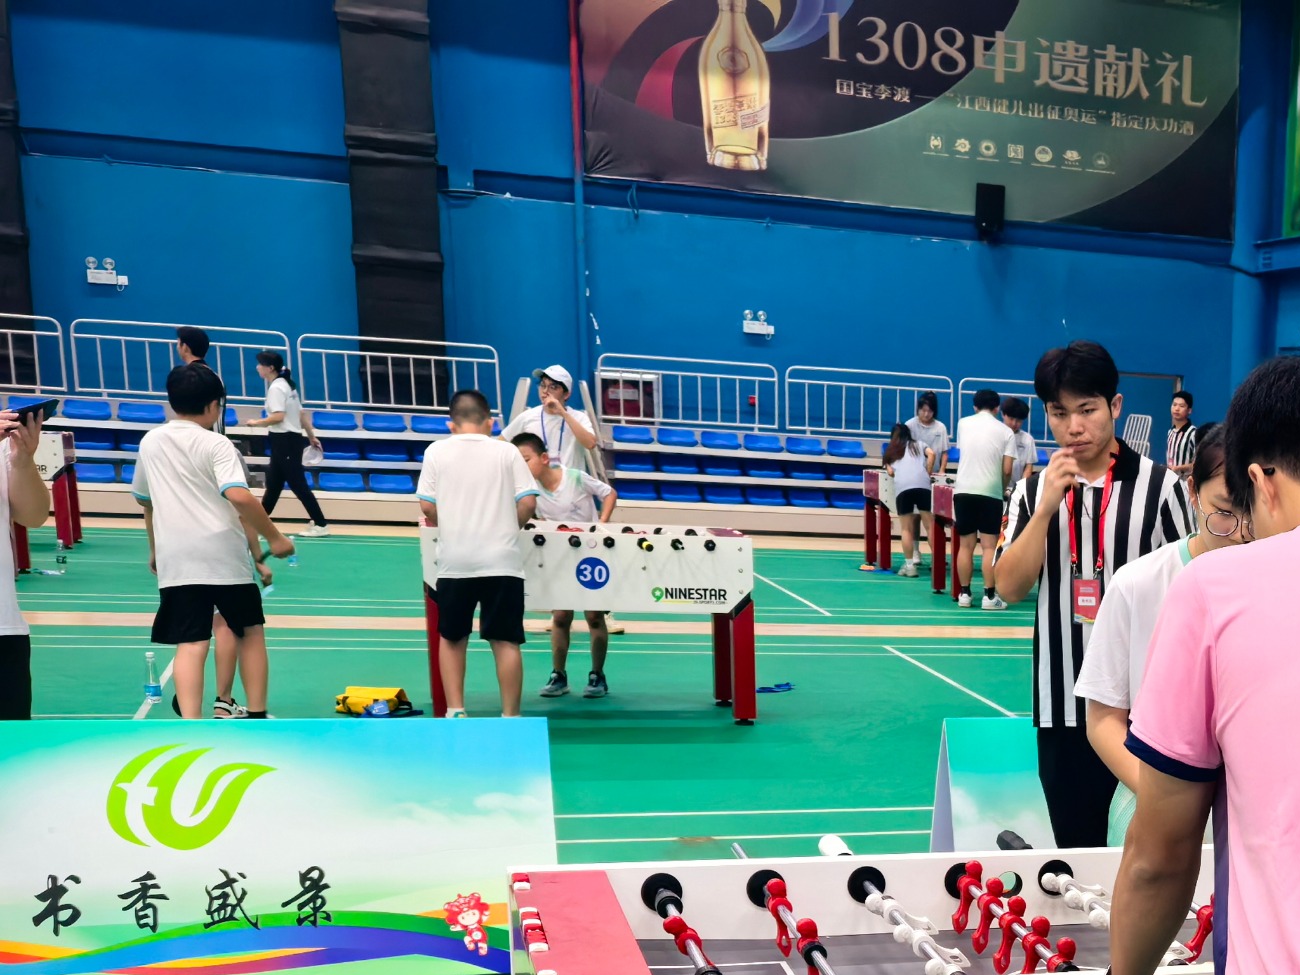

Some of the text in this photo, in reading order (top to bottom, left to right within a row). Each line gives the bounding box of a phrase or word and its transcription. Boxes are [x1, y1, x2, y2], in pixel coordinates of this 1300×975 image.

[821, 12, 1208, 107] 1308申遗献礼
[835, 78, 911, 103] 国宝李渡
[579, 564, 607, 583] 30
[664, 587, 728, 601] NINESTAR
[32, 866, 334, 937] 书香盛景
